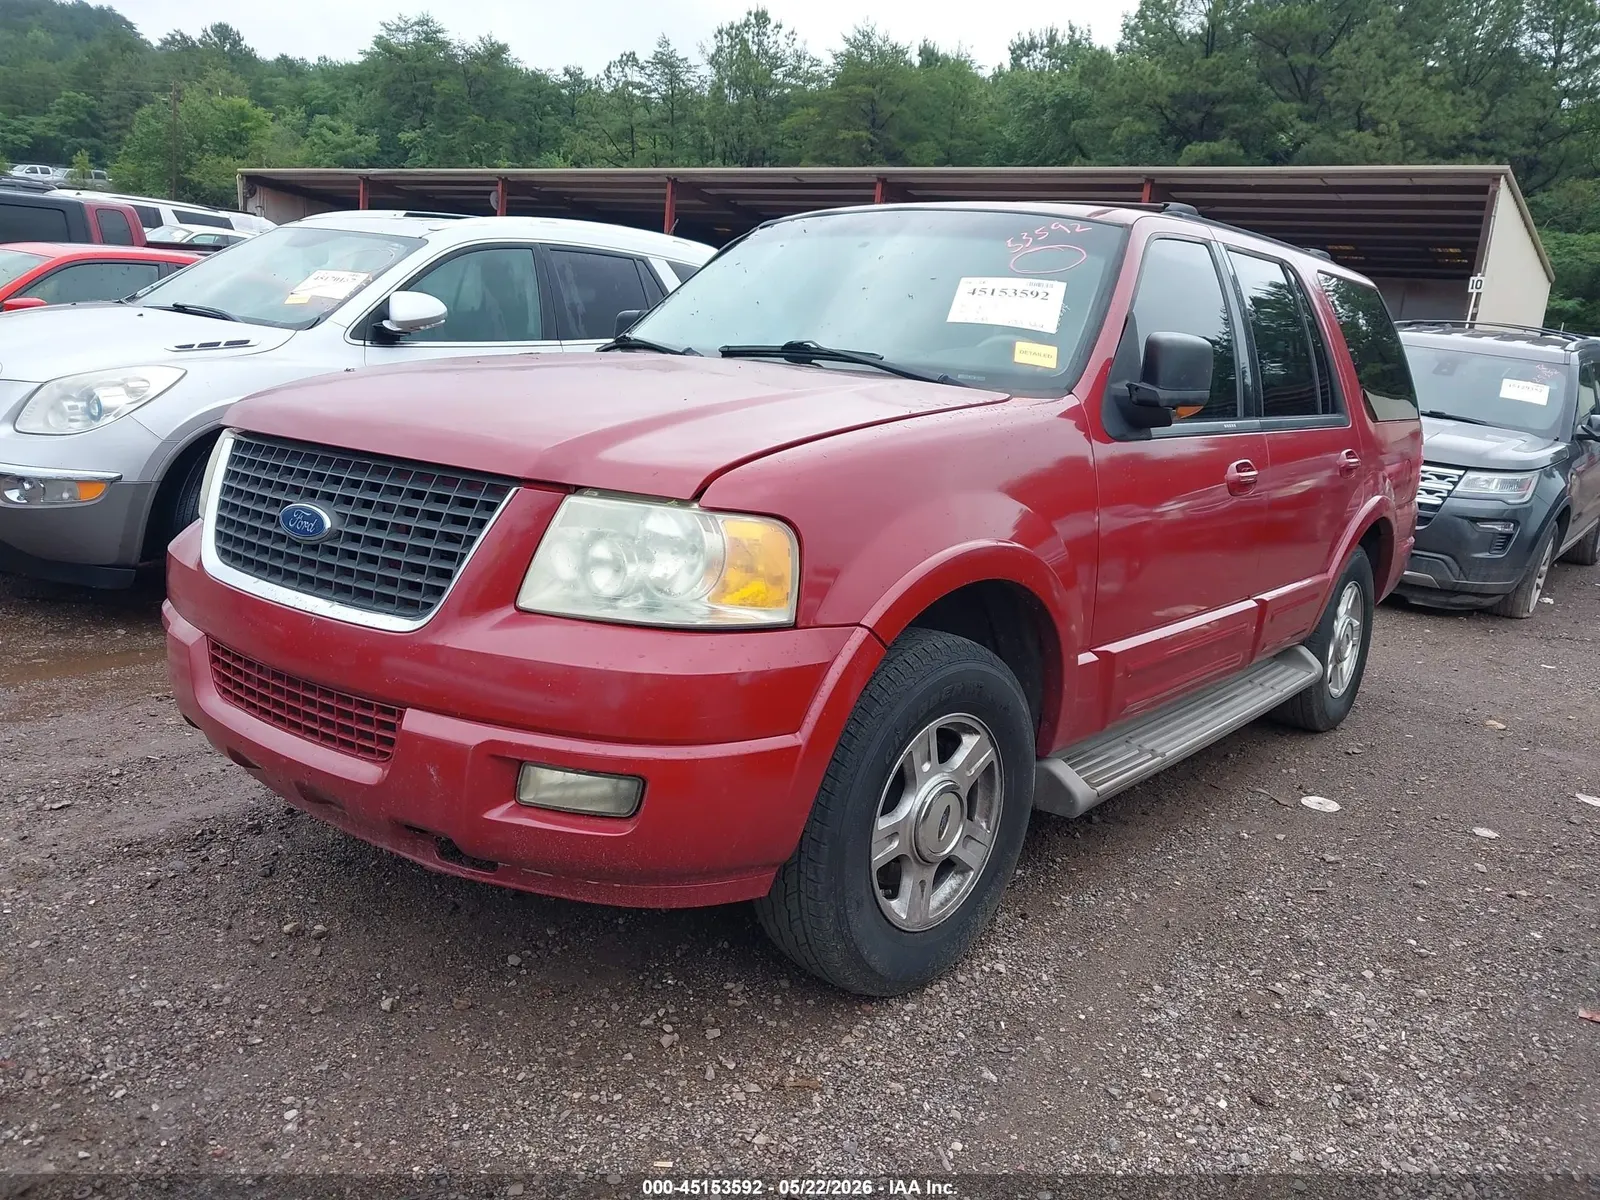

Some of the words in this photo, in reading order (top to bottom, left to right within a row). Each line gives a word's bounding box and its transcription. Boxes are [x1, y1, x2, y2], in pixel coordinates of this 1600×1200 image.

[1006, 222, 1093, 253] 53592
[1470, 279, 1483, 290] 10
[967, 287, 1050, 301] 45153592
[1019, 349, 1054, 360] DETAILED
[288, 509, 318, 533] Ford
